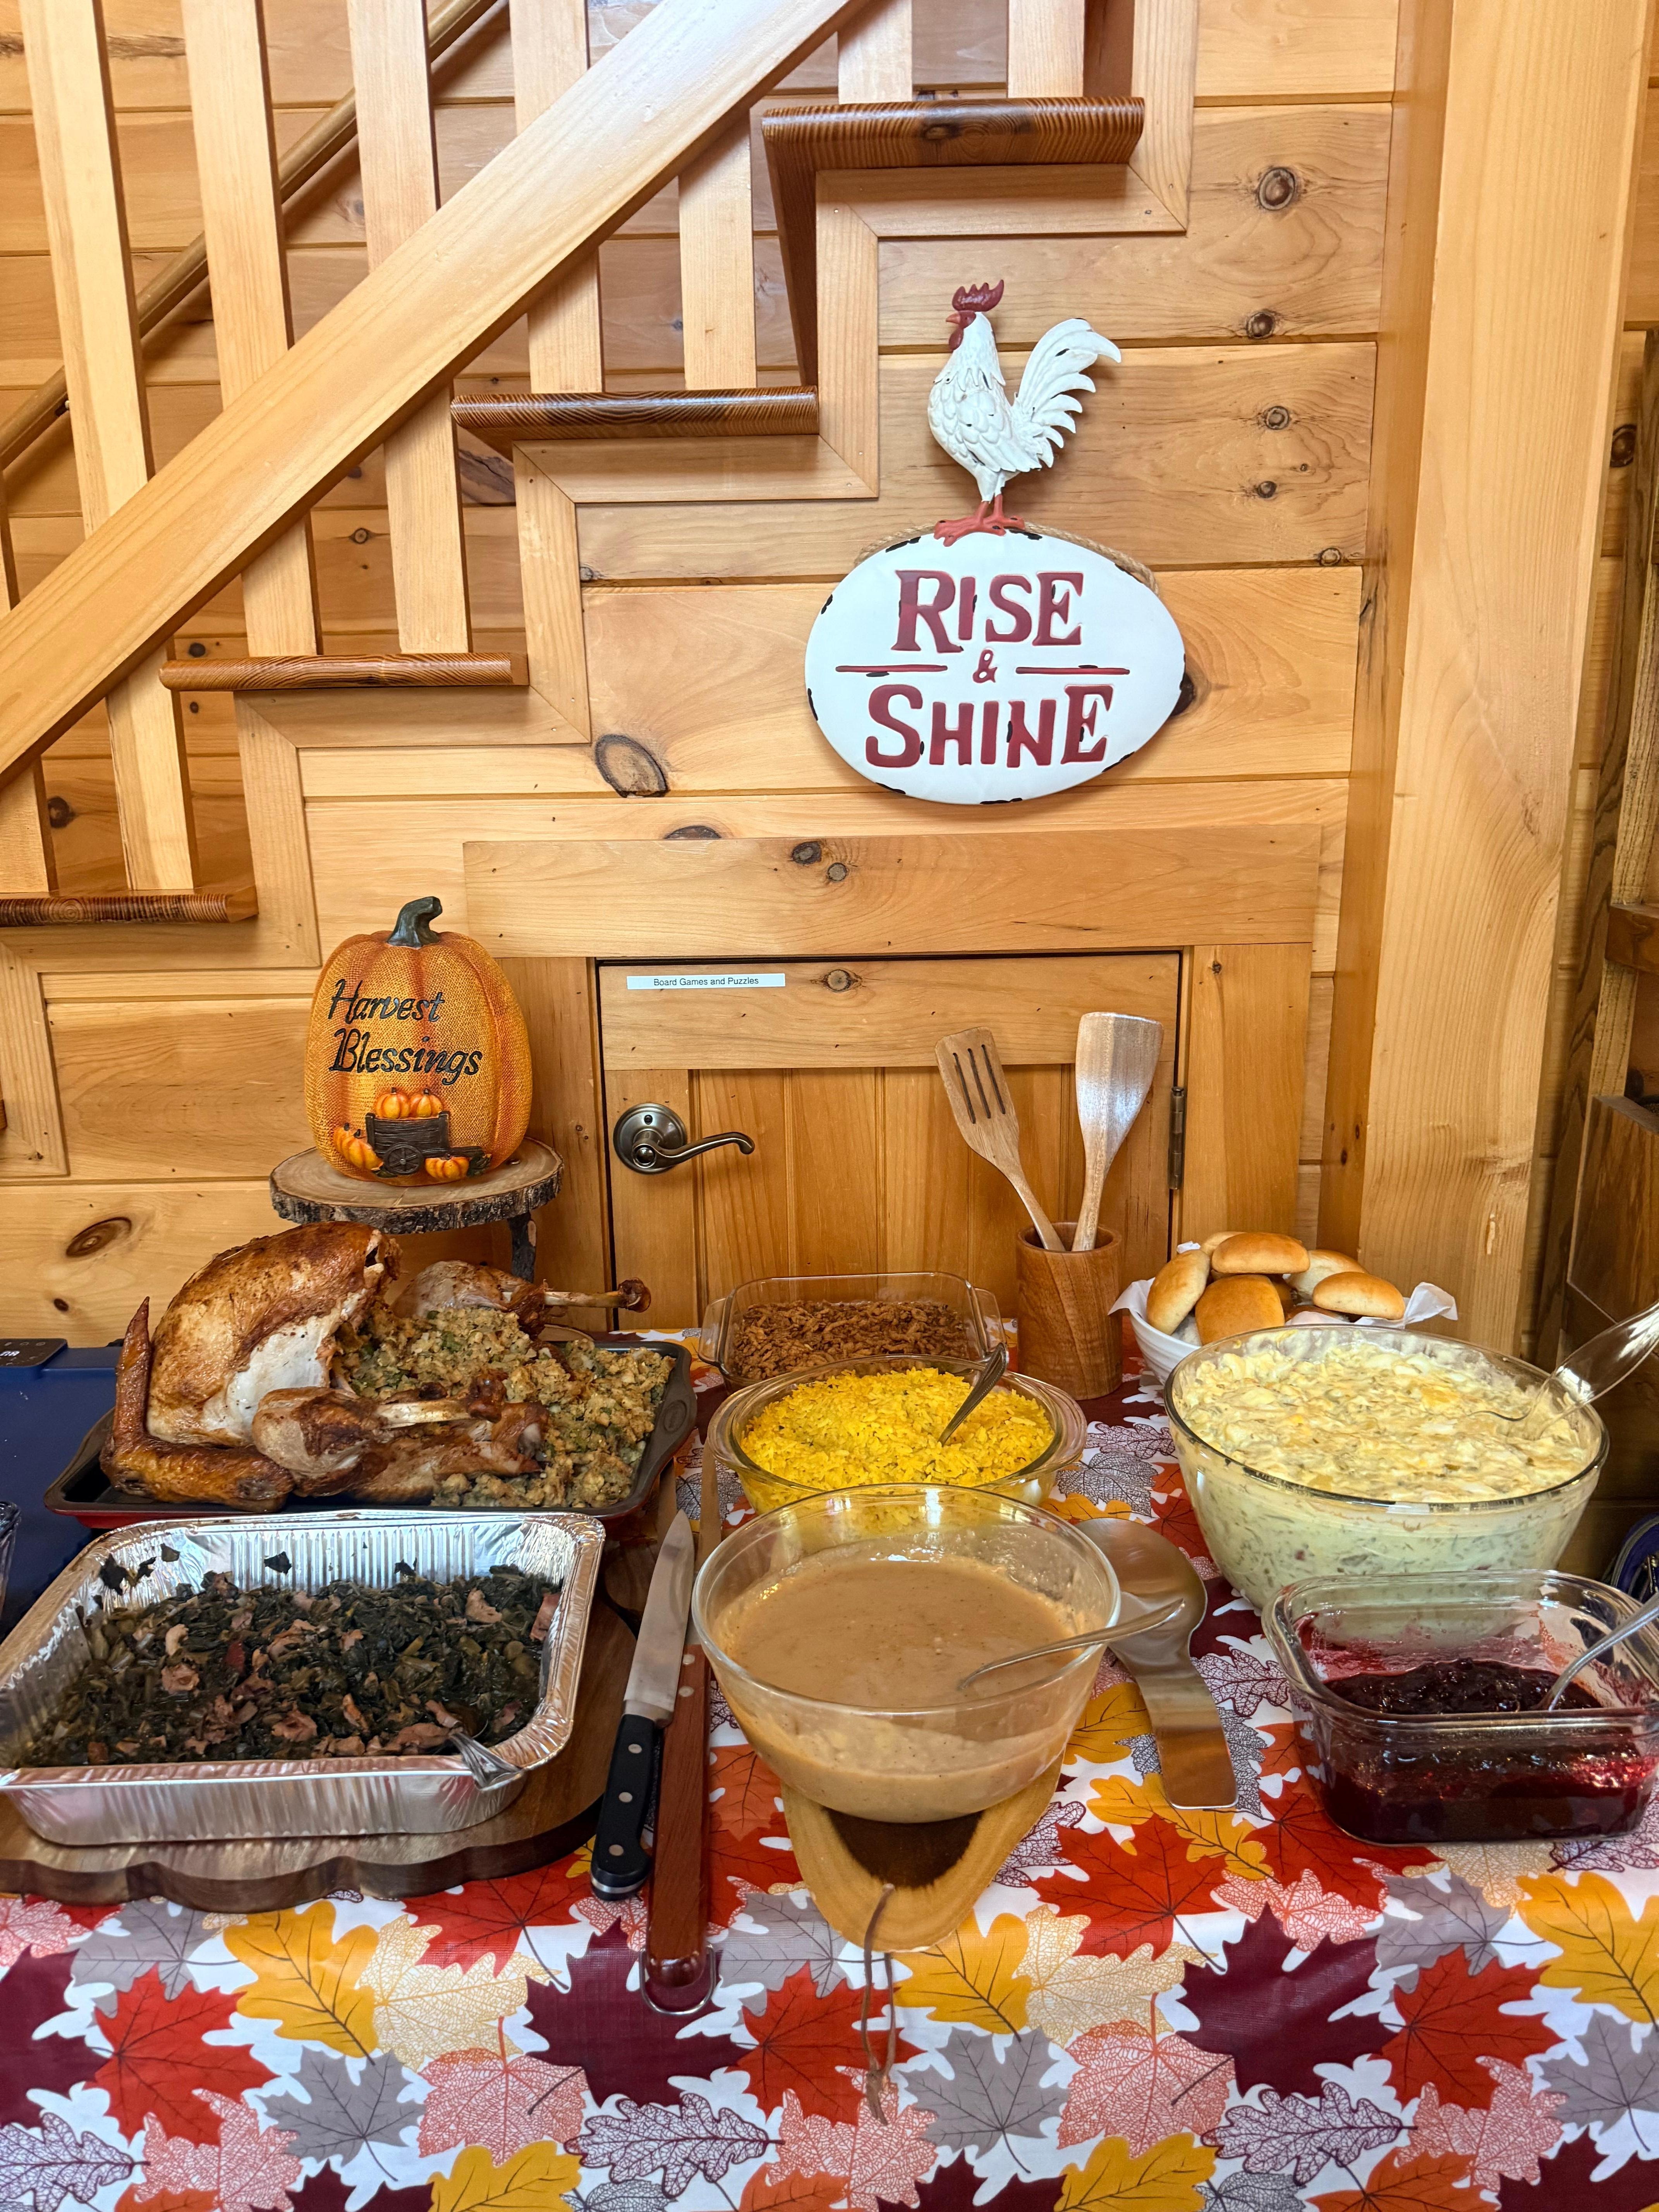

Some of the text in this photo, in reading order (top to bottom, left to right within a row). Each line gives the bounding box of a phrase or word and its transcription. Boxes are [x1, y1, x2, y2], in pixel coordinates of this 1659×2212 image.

[891, 570, 1084, 653] RISE
[972, 649, 997, 684] &
[866, 684, 1114, 768] SHINE
[328, 979, 445, 1025] Harvest
[328, 1027, 483, 1086] Blessings
